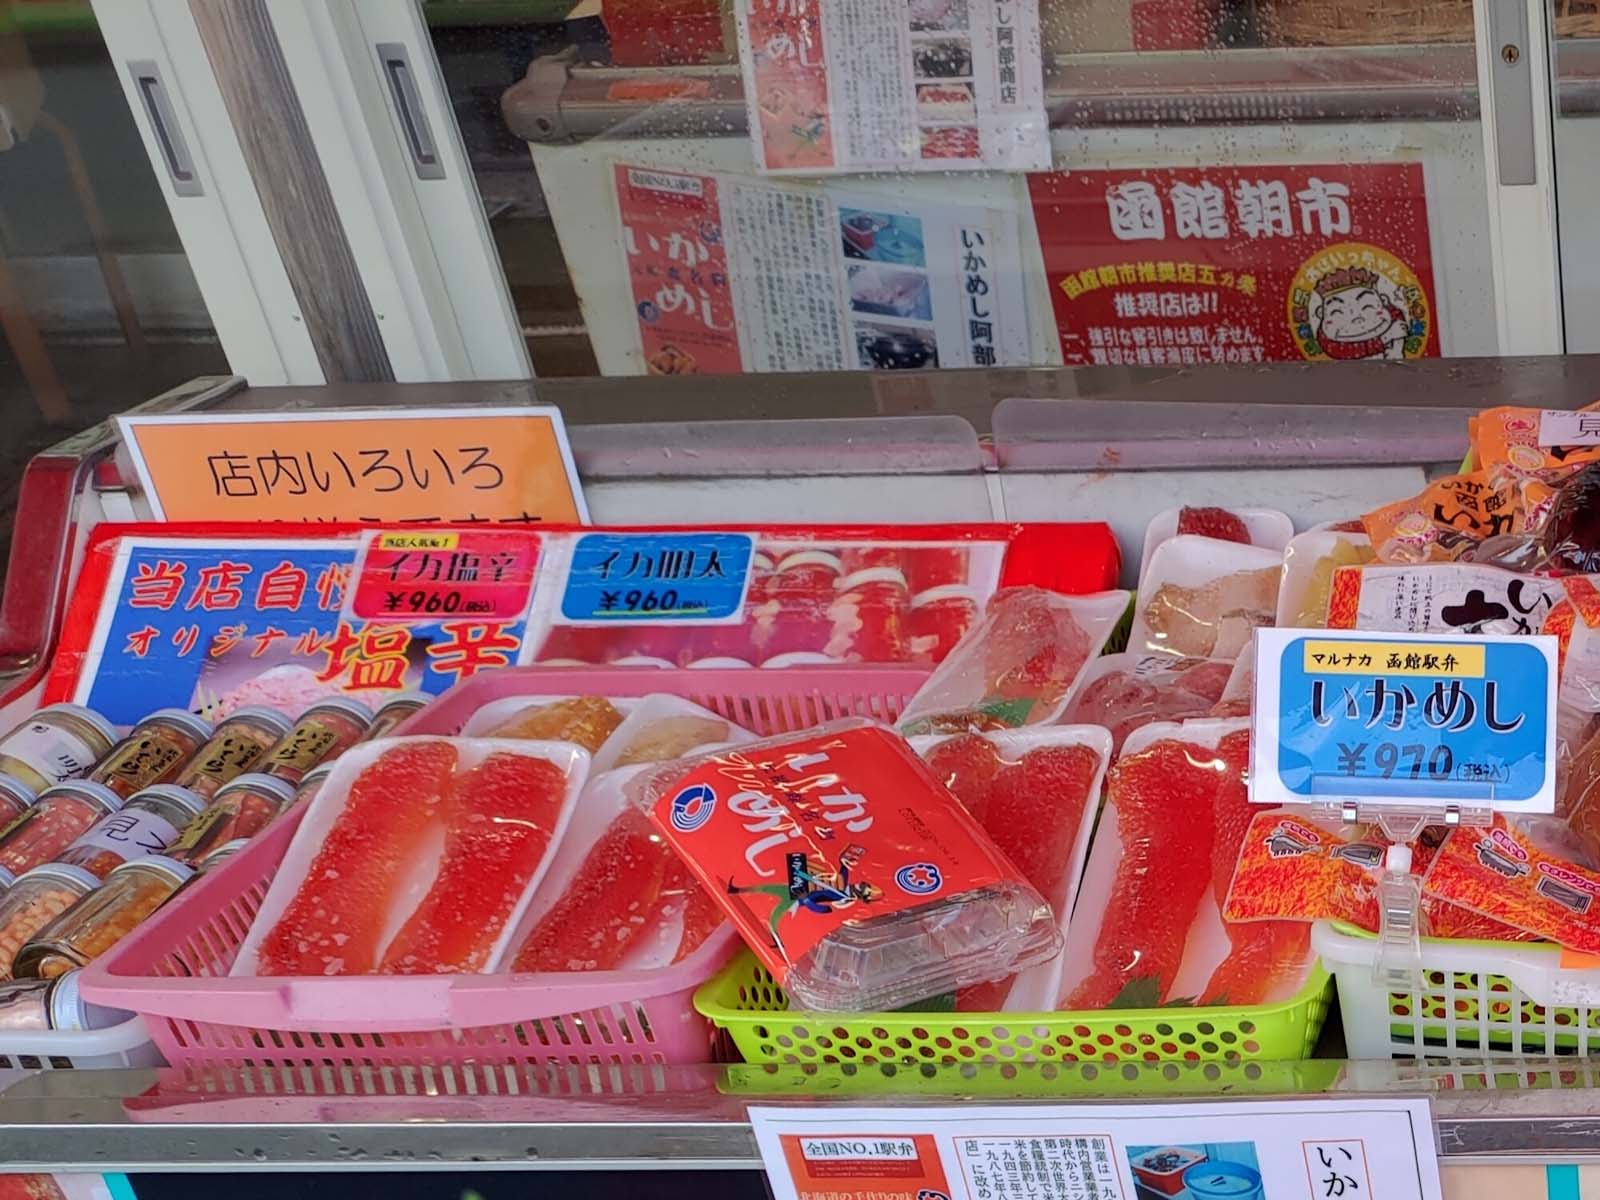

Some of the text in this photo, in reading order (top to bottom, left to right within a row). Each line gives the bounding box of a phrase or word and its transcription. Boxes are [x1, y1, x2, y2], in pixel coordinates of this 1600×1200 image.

[1105, 177, 1351, 240] 函館朝市
[961, 227, 997, 366] いかめし阿部
[206, 444, 505, 499] 店内いろいろ
[1311, 651, 1460, 672] マルナカ 函館駅弁
[1309, 677, 1526, 733] いかめし
[805, 1140, 915, 1160] 全国NO.1駅弁
